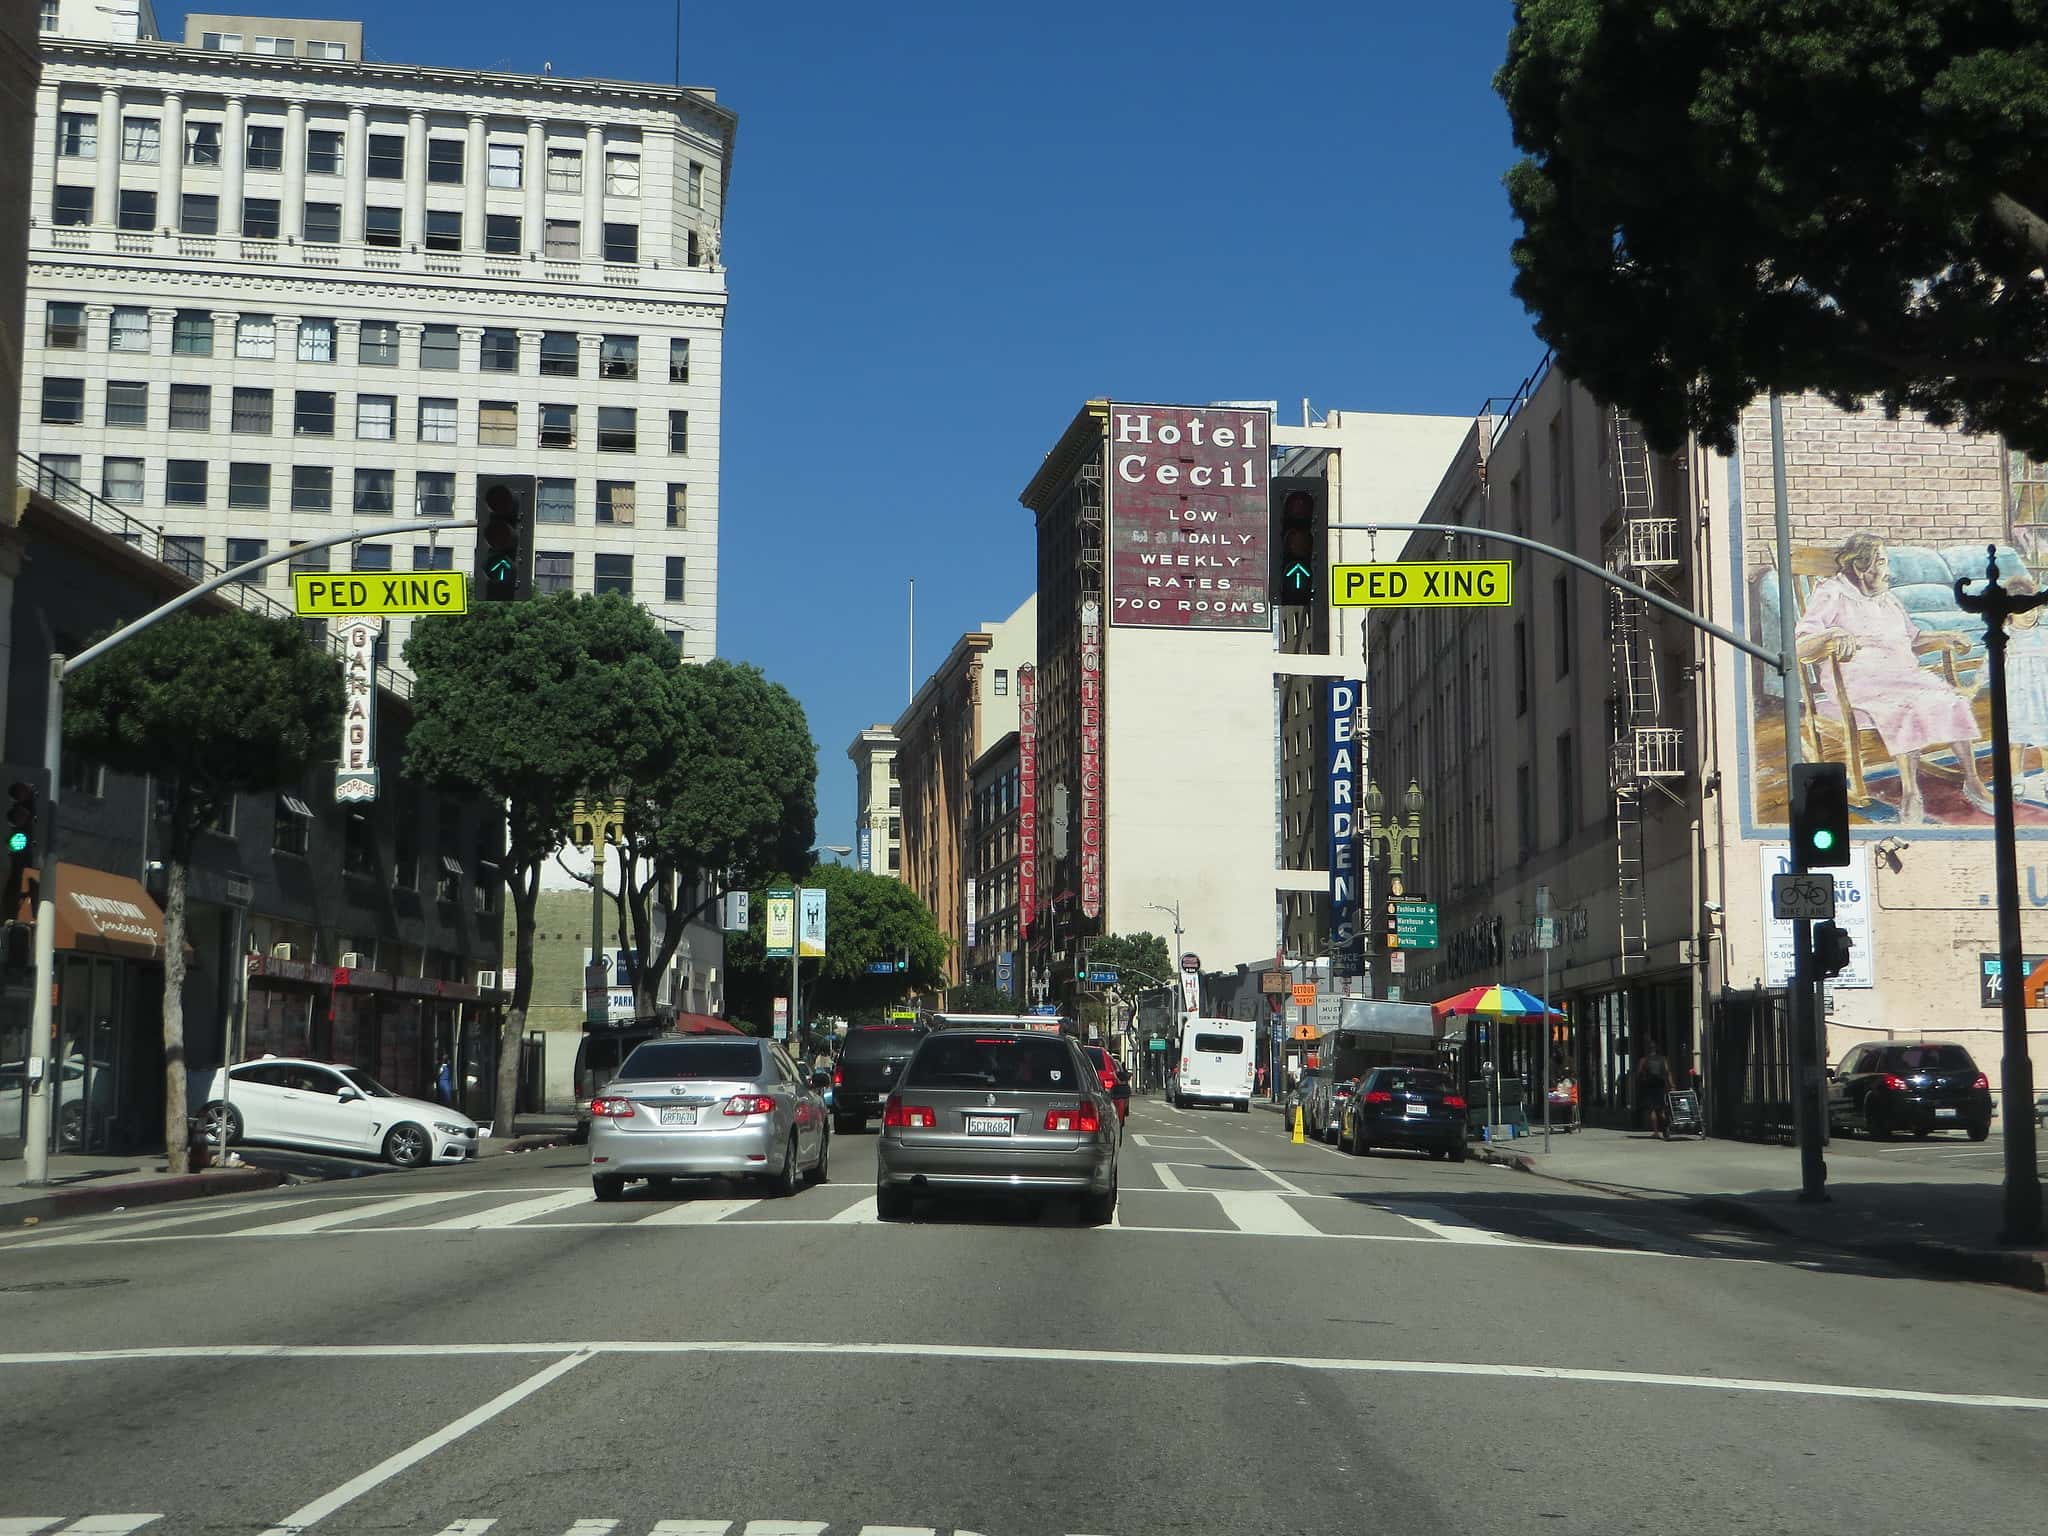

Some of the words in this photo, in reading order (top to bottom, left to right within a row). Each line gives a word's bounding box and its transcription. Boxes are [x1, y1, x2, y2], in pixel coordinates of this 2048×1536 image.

[1115, 414, 1257, 449] Hotel
[1118, 454, 1257, 488] Cecil
[1169, 509, 1218, 522] LOW
[1188, 533, 1252, 545] DAILY
[1140, 553, 1241, 567] WEEKLY
[308, 581, 367, 607] PED
[382, 579, 451, 606] XING
[1147, 576, 1232, 590] RATES
[1346, 571, 1408, 599] PED
[1423, 569, 1495, 598] XING
[1114, 598, 1161, 610] 700
[1177, 600, 1266, 614] ROOMS
[349, 626, 367, 770] GARAGE
[1083, 624, 1098, 755] HOTEL
[336, 780, 376, 798] STORAGE
[1083, 770, 1098, 903] CECIL
[1020, 812, 1035, 927] CECIL
[1293, 985, 1315, 994] DETOUR
